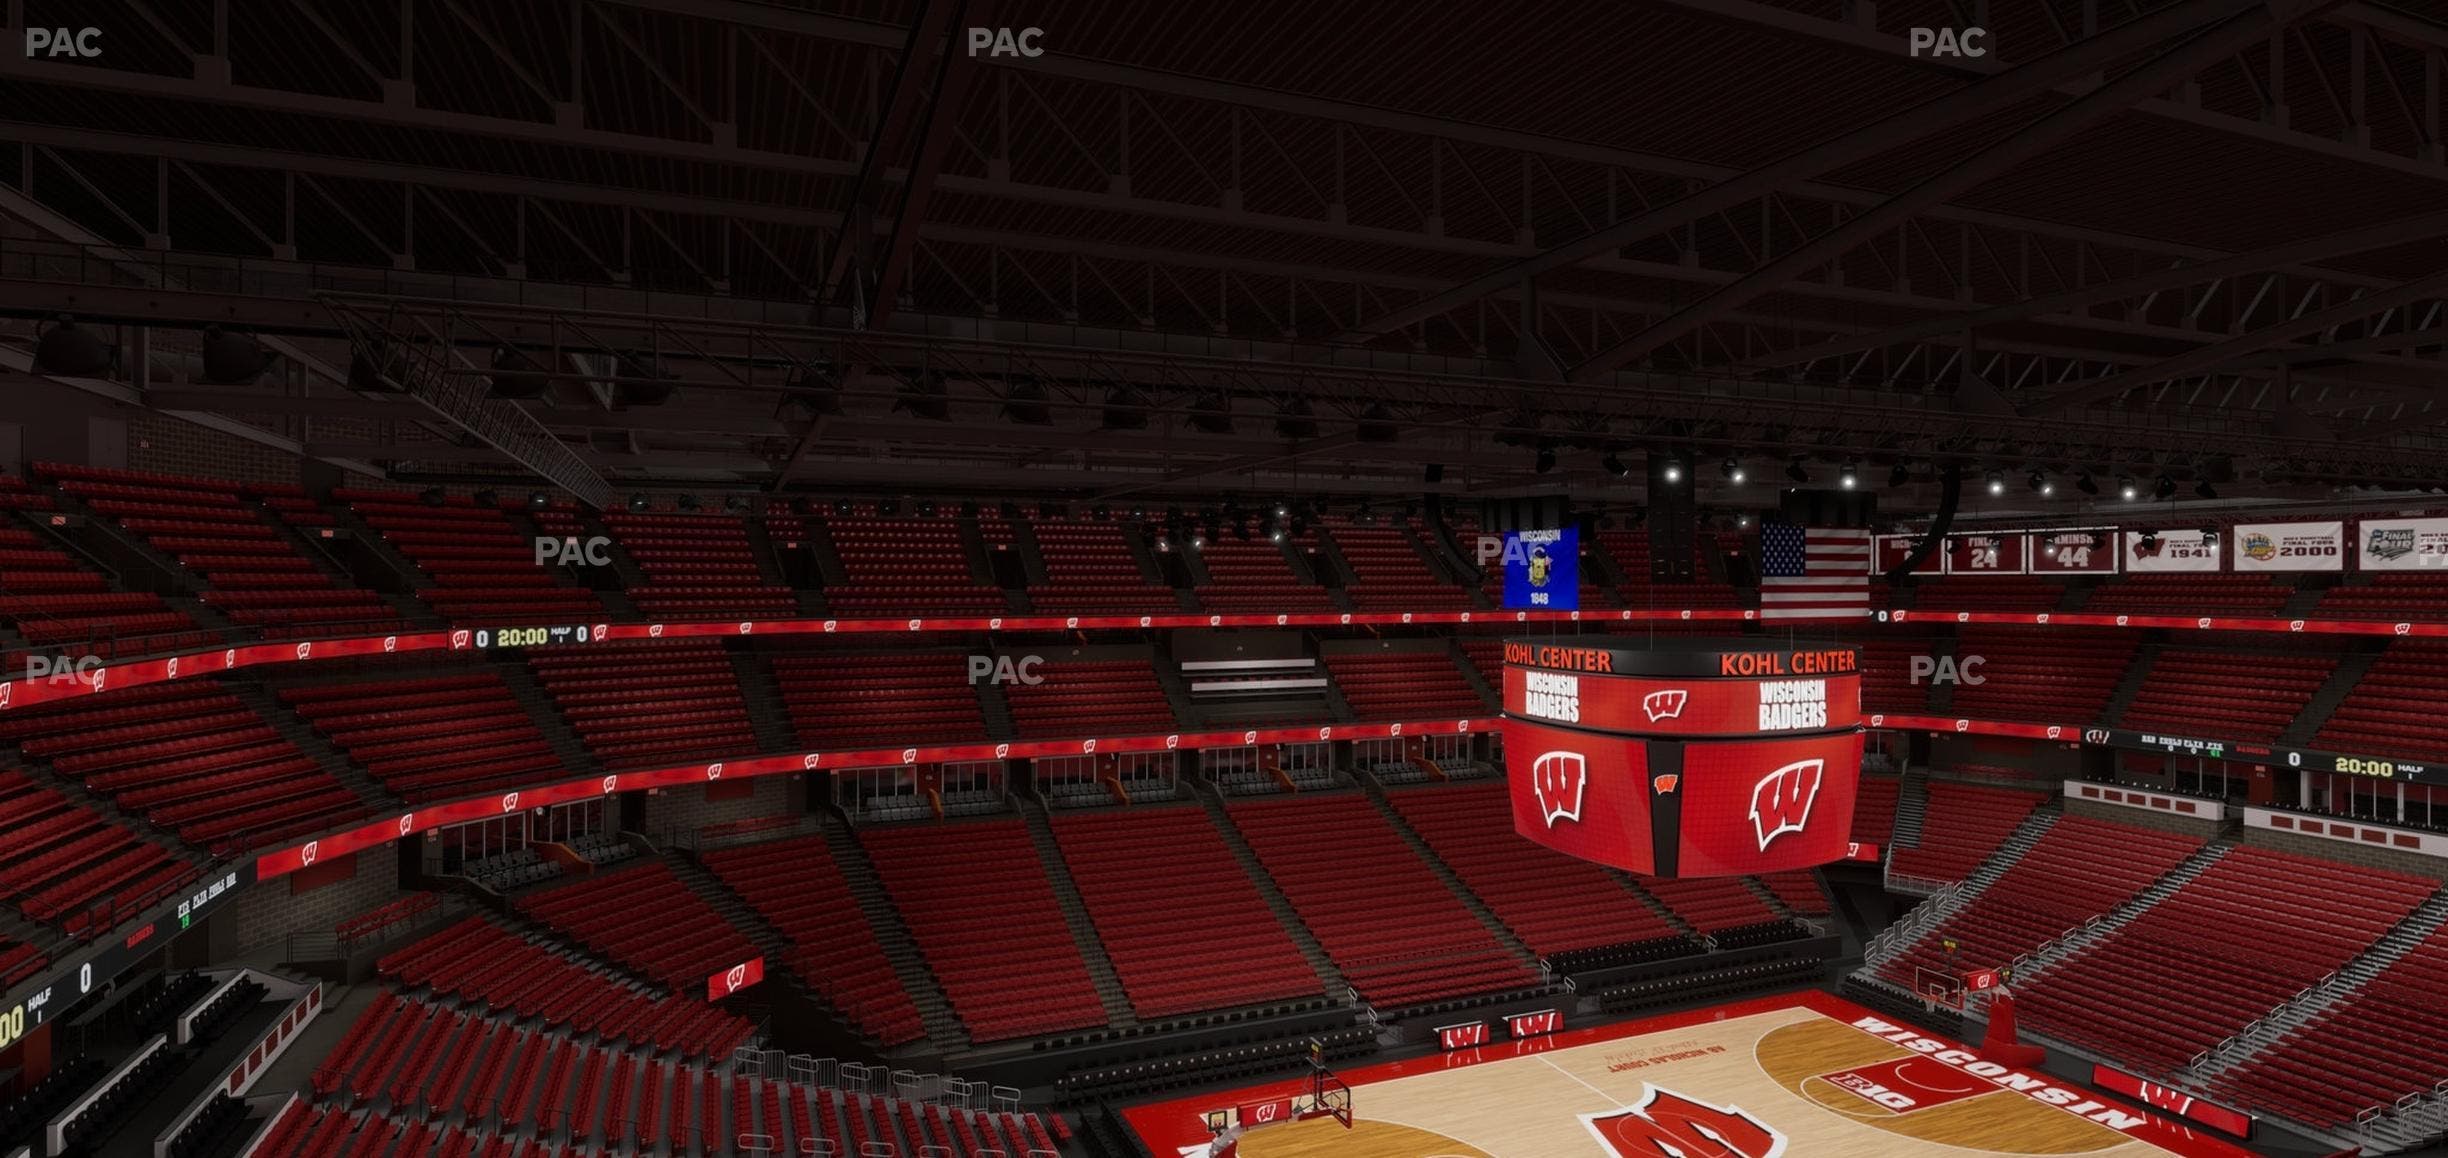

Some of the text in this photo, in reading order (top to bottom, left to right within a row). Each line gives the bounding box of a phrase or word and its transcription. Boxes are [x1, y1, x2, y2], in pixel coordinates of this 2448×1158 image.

[1519, 529, 1561, 543] WISCONSIN
[1971, 549, 1997, 568] 24
[2057, 547, 2089, 567] 44
[2170, 549, 2211, 558] 1941
[2280, 547, 2337, 556] 2000
[1530, 592, 1549, 605] 1848
[1878, 610, 1888, 622] 0
[475, 630, 490, 649] 0
[498, 628, 549, 648] 20:00
[551, 626, 572, 636] HALF
[576, 625, 588, 643] 0
[1505, 642, 1613, 673] KOHL CENTER
[1721, 649, 1856, 676] KOHL CENTER
[1525, 671, 1579, 698] WISCONSIN
[1758, 679, 1827, 704] WISCONSIN
[1525, 691, 1580, 723] BADGERS
[1643, 689, 1687, 724] W
[1758, 701, 1828, 731] BADGERS
[2287, 751, 2301, 767] 0
[2335, 756, 2394, 778] 20:00
[2397, 763, 2425, 773] HALF
[1532, 750, 1587, 830] W
[1747, 757, 1826, 853] W
[28, 986, 51, 1013] HALF
[80, 962, 92, 994] 0
[726, 963, 746, 993] W
[1852, 1016, 2148, 1130] WISCONSIN
